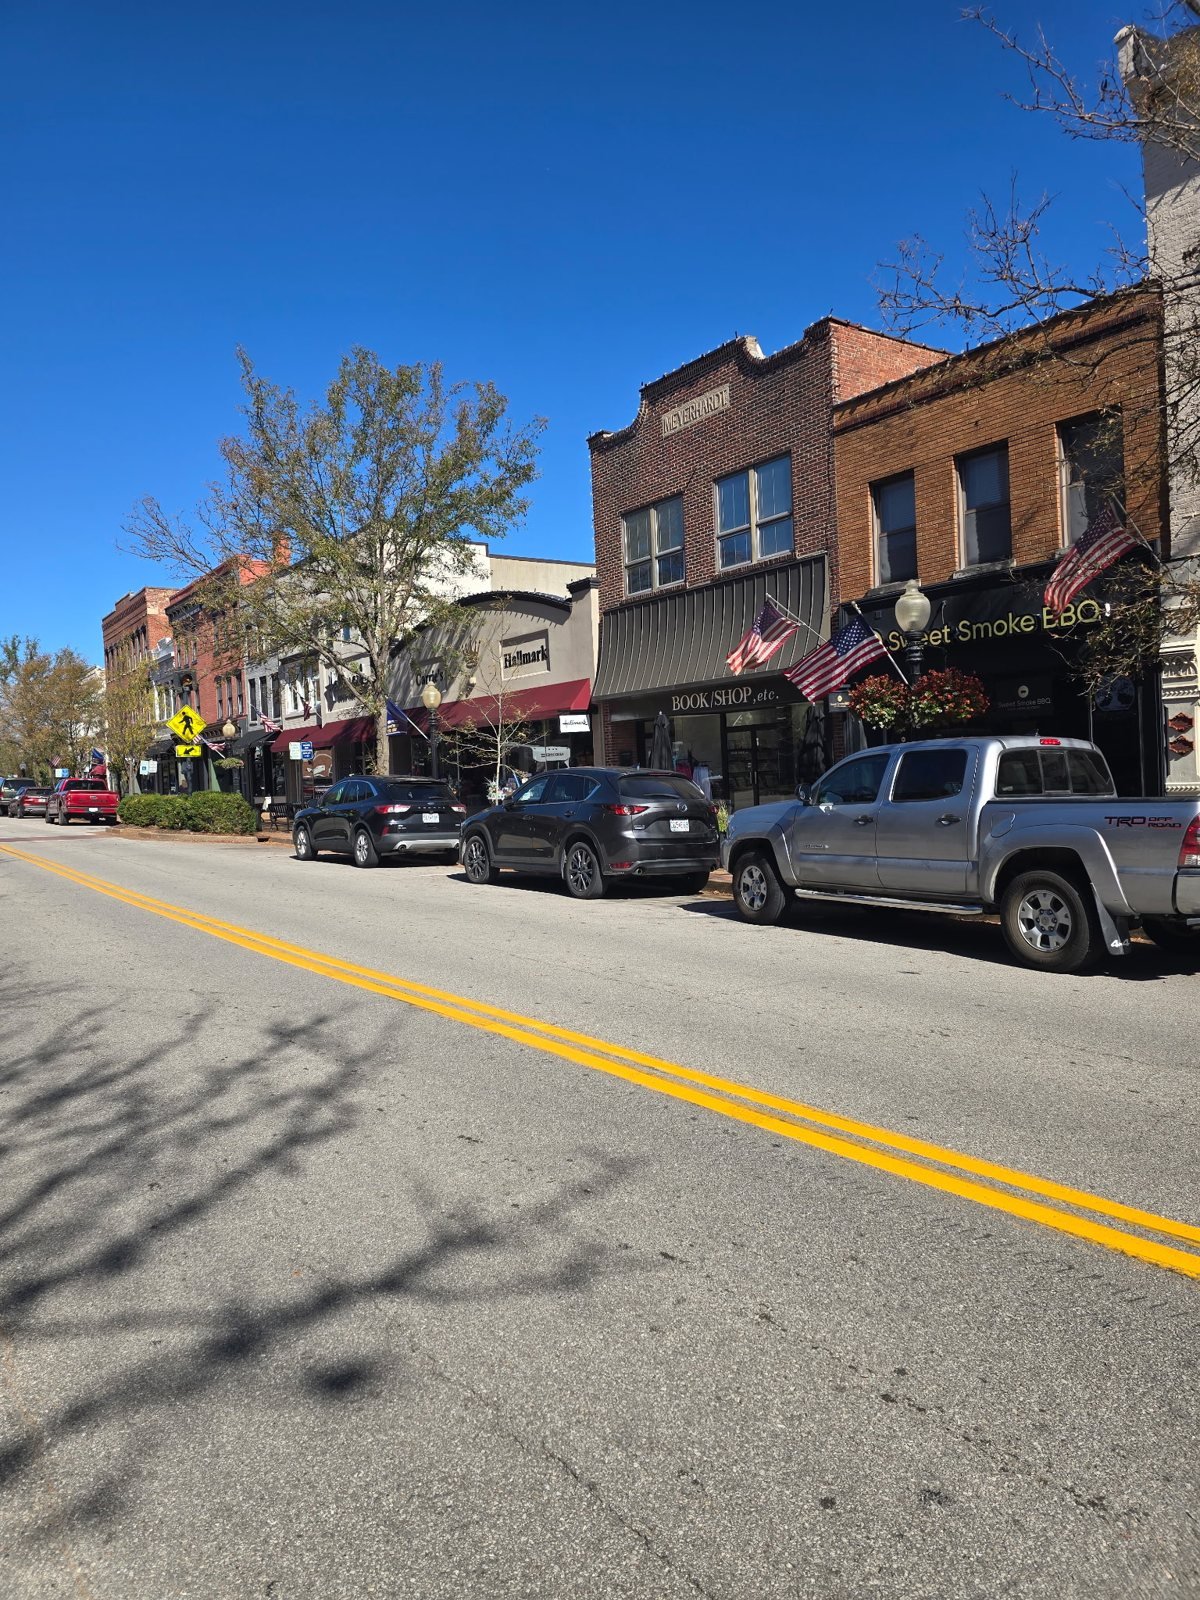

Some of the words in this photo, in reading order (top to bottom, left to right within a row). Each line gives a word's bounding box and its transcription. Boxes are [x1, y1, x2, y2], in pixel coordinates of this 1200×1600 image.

[663, 389, 727, 434] MEYERHARDT
[888, 627, 951, 651] Set
[958, 612, 1035, 641] Smoke
[504, 645, 548, 669] Hallmark
[1104, 816, 1146, 827] TRD
